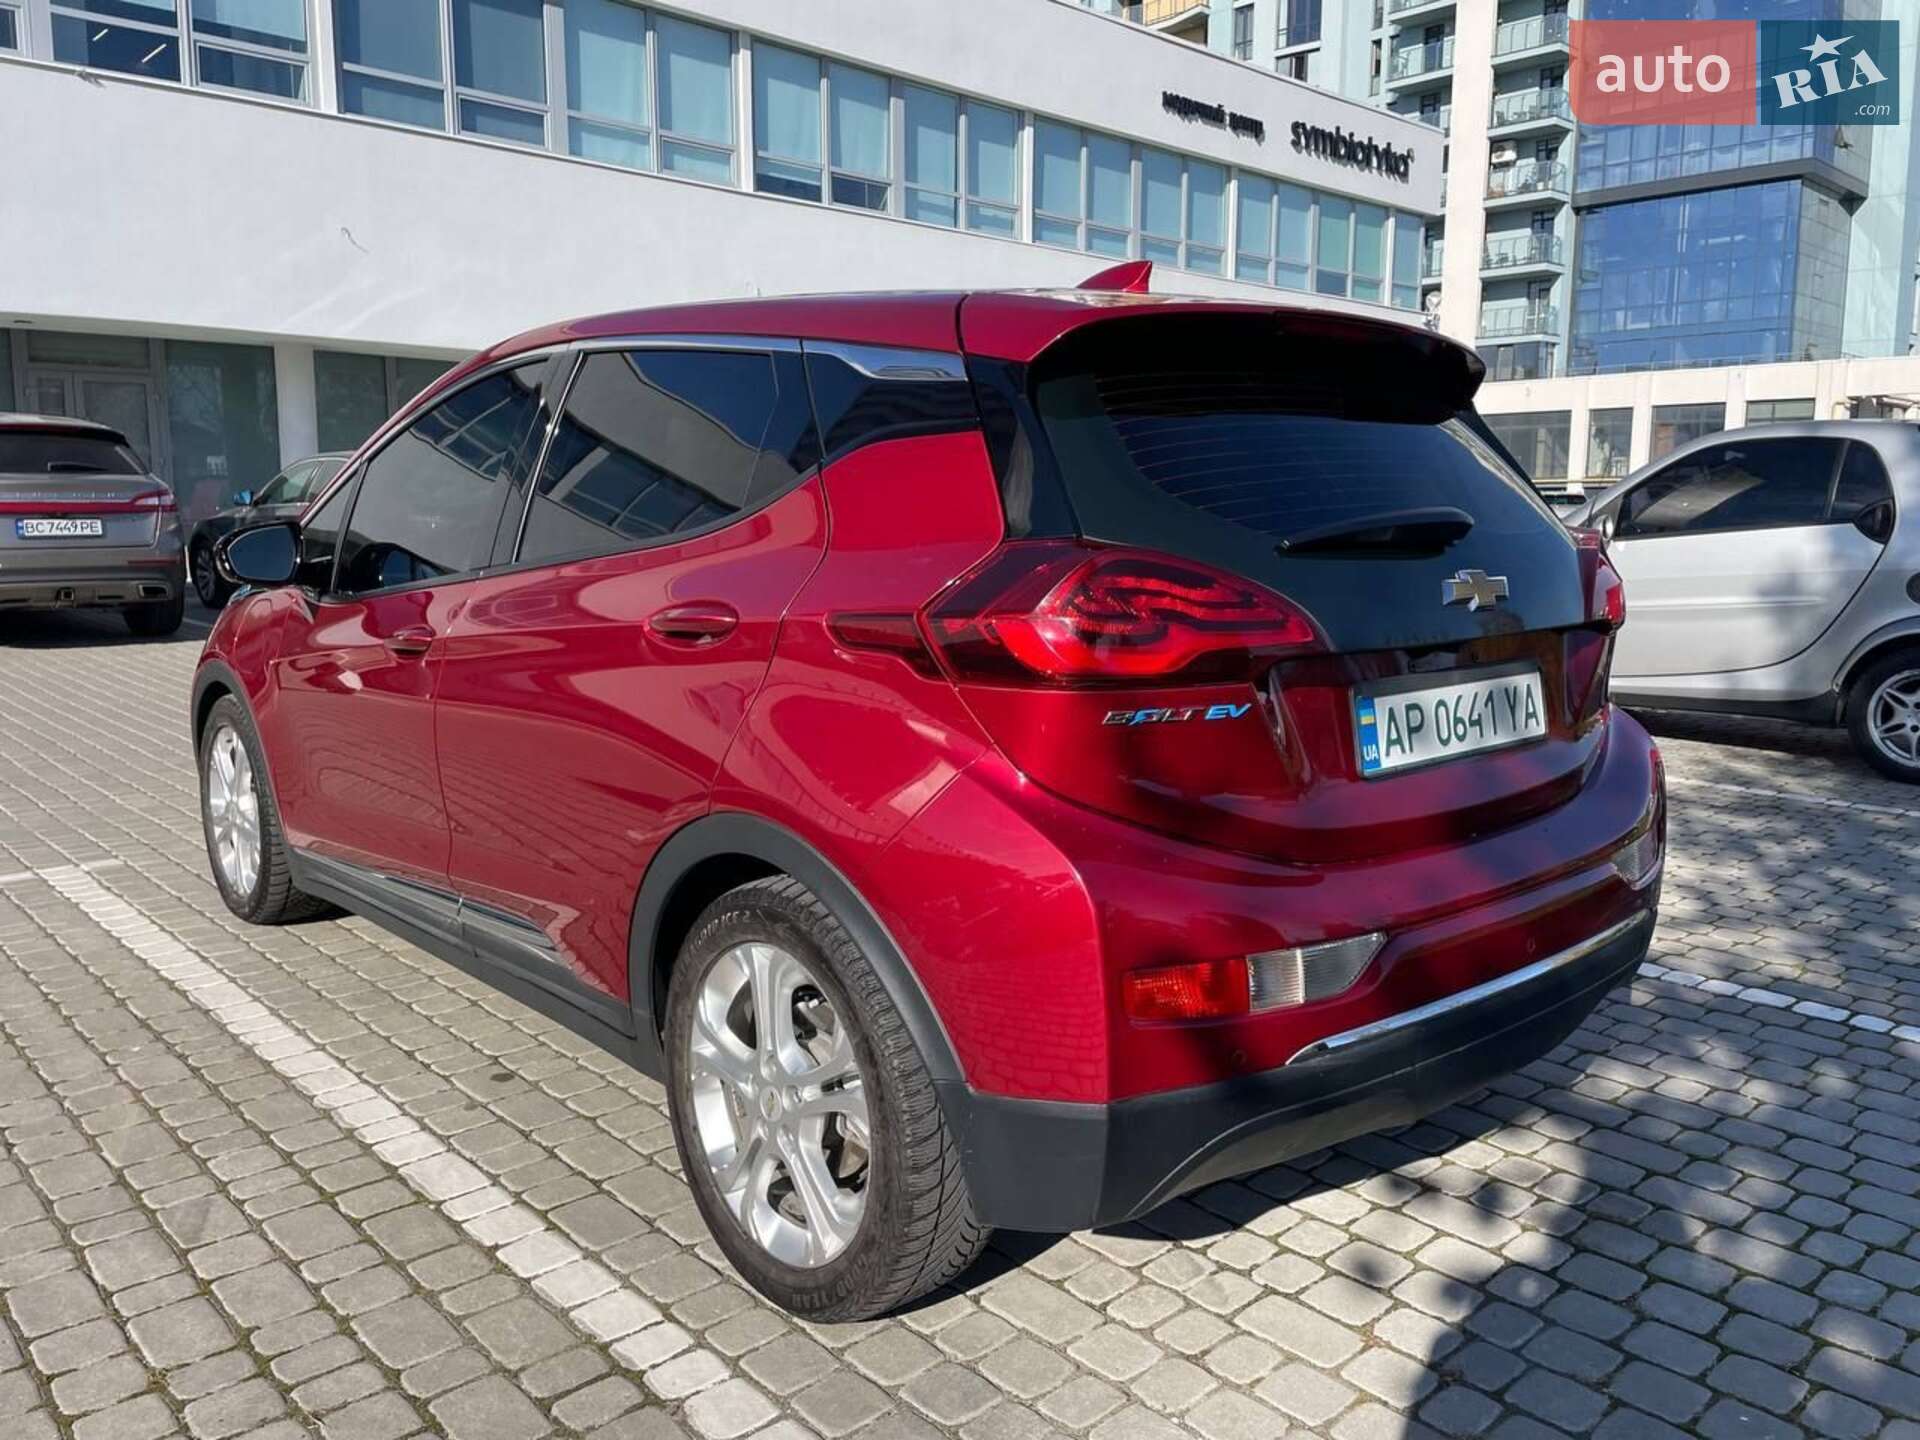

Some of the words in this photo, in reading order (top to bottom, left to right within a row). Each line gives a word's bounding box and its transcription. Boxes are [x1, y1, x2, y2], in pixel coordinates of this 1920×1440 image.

[24, 521, 46, 534] BC
[48, 521, 78, 534] 7449
[80, 521, 101, 534] PE
[1101, 706, 1205, 726] BOLT
[1204, 703, 1252, 721] EV
[1384, 703, 1425, 757] AP
[1434, 689, 1498, 747] 0641
[1503, 683, 1540, 732] YA
[1362, 742, 1380, 761] UA
